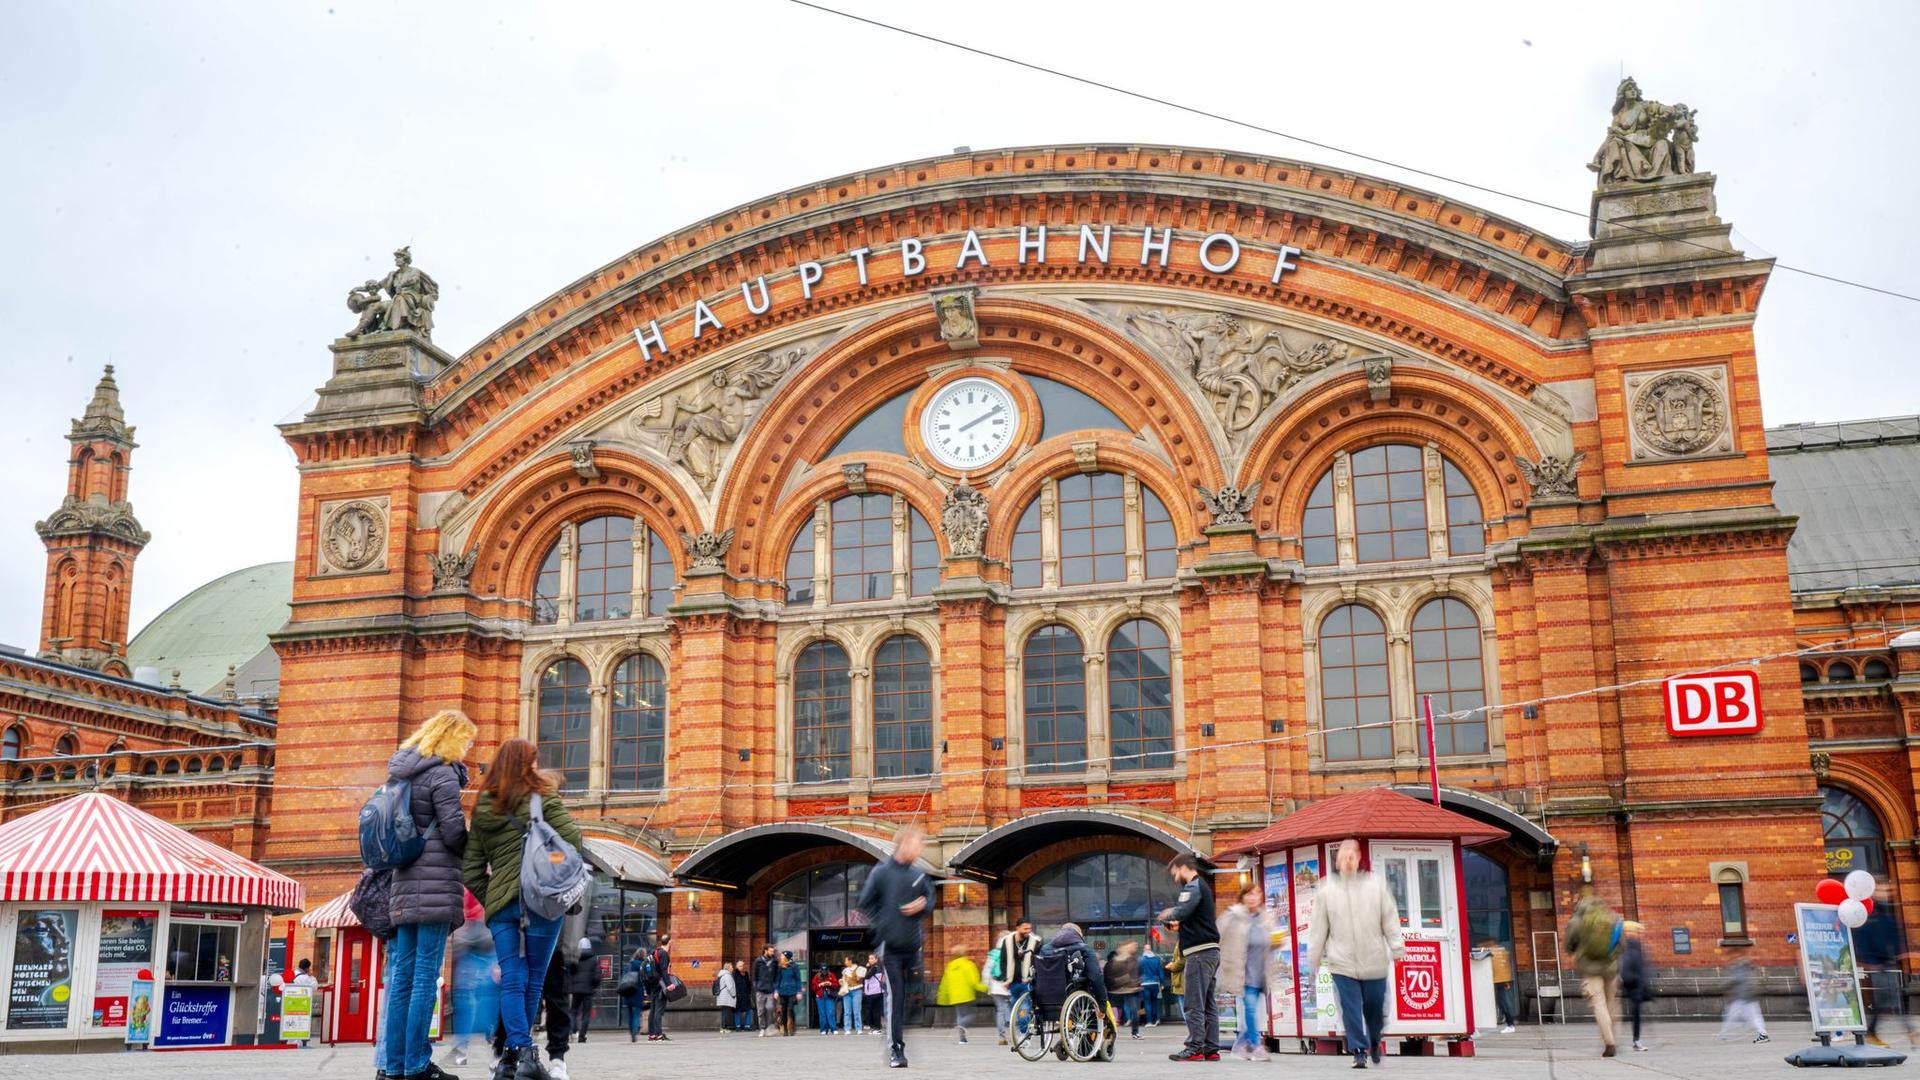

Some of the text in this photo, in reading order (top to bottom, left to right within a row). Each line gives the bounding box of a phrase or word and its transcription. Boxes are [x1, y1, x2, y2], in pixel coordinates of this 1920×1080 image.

[633, 224, 1301, 362] HAUPTBAHNHOF
[1676, 681, 1750, 725] DB
[1407, 970, 1431, 991] 70
[171, 991, 182, 999] Ein
[169, 1001, 218, 1016] Glückstreffer
